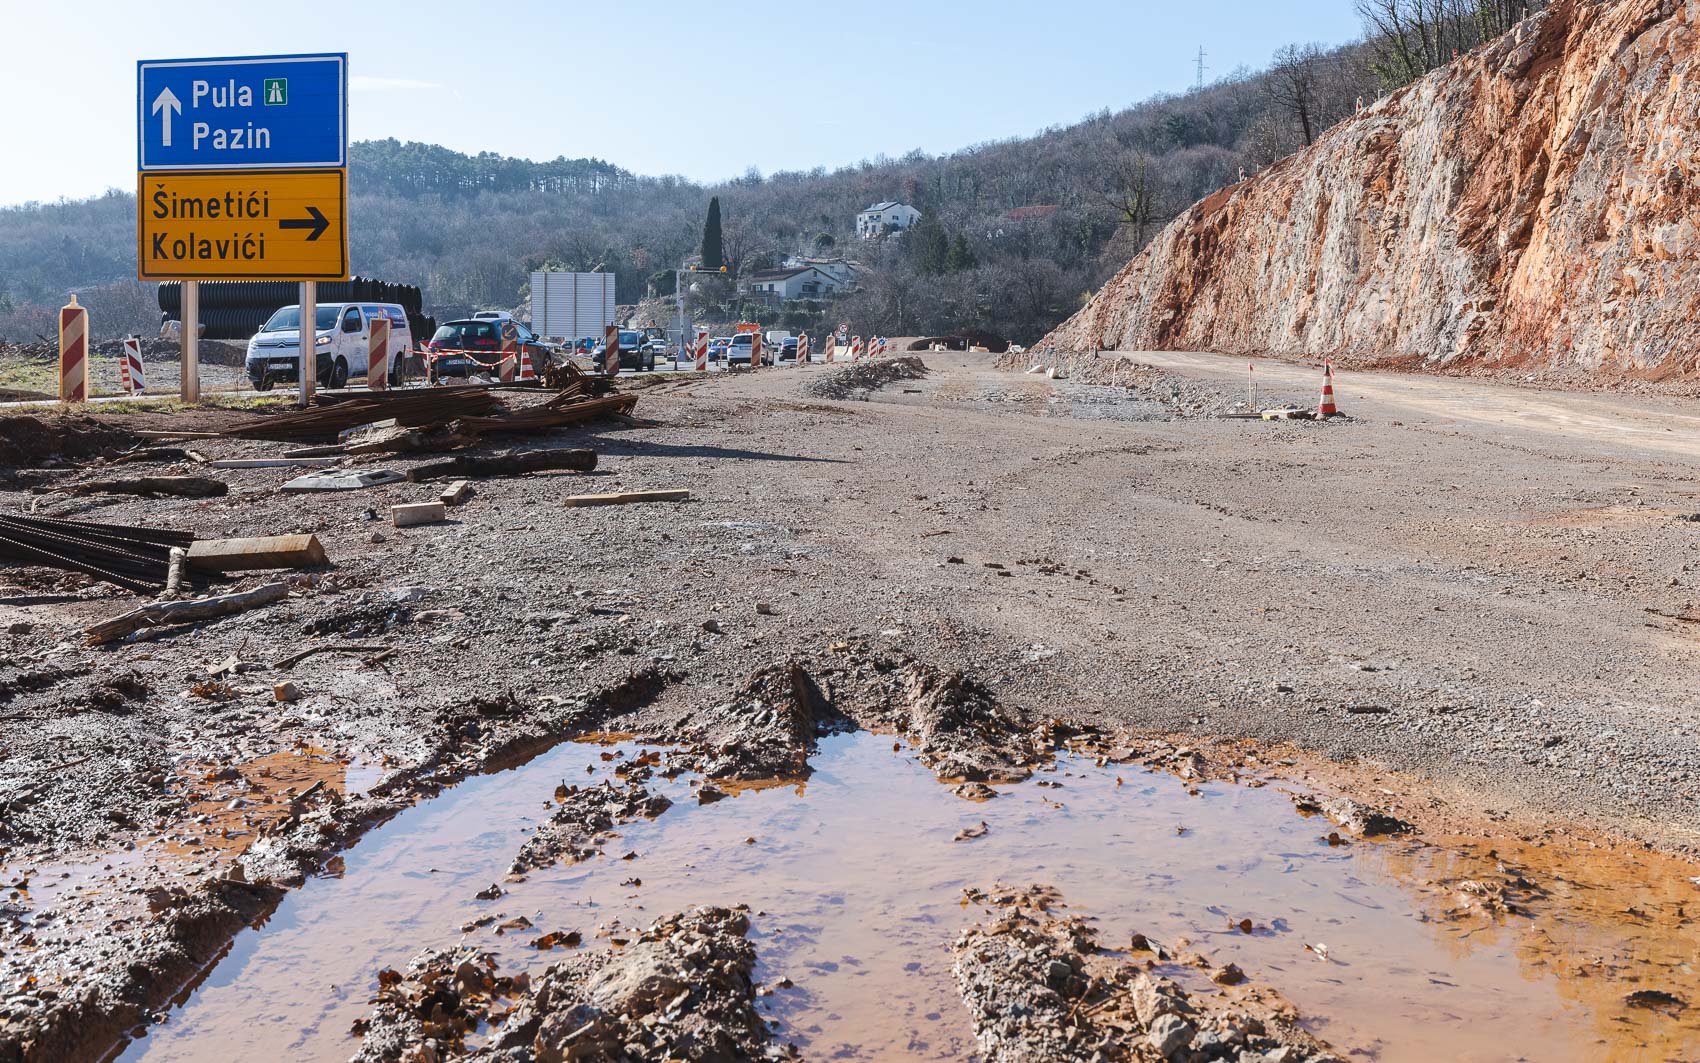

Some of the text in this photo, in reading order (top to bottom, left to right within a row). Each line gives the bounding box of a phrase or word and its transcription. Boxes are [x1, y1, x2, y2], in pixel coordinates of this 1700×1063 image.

[192, 79, 253, 108] Pula
[193, 121, 270, 150] Pazin
[153, 184, 269, 219] Šimetići
[152, 232, 265, 260] Kolavići
